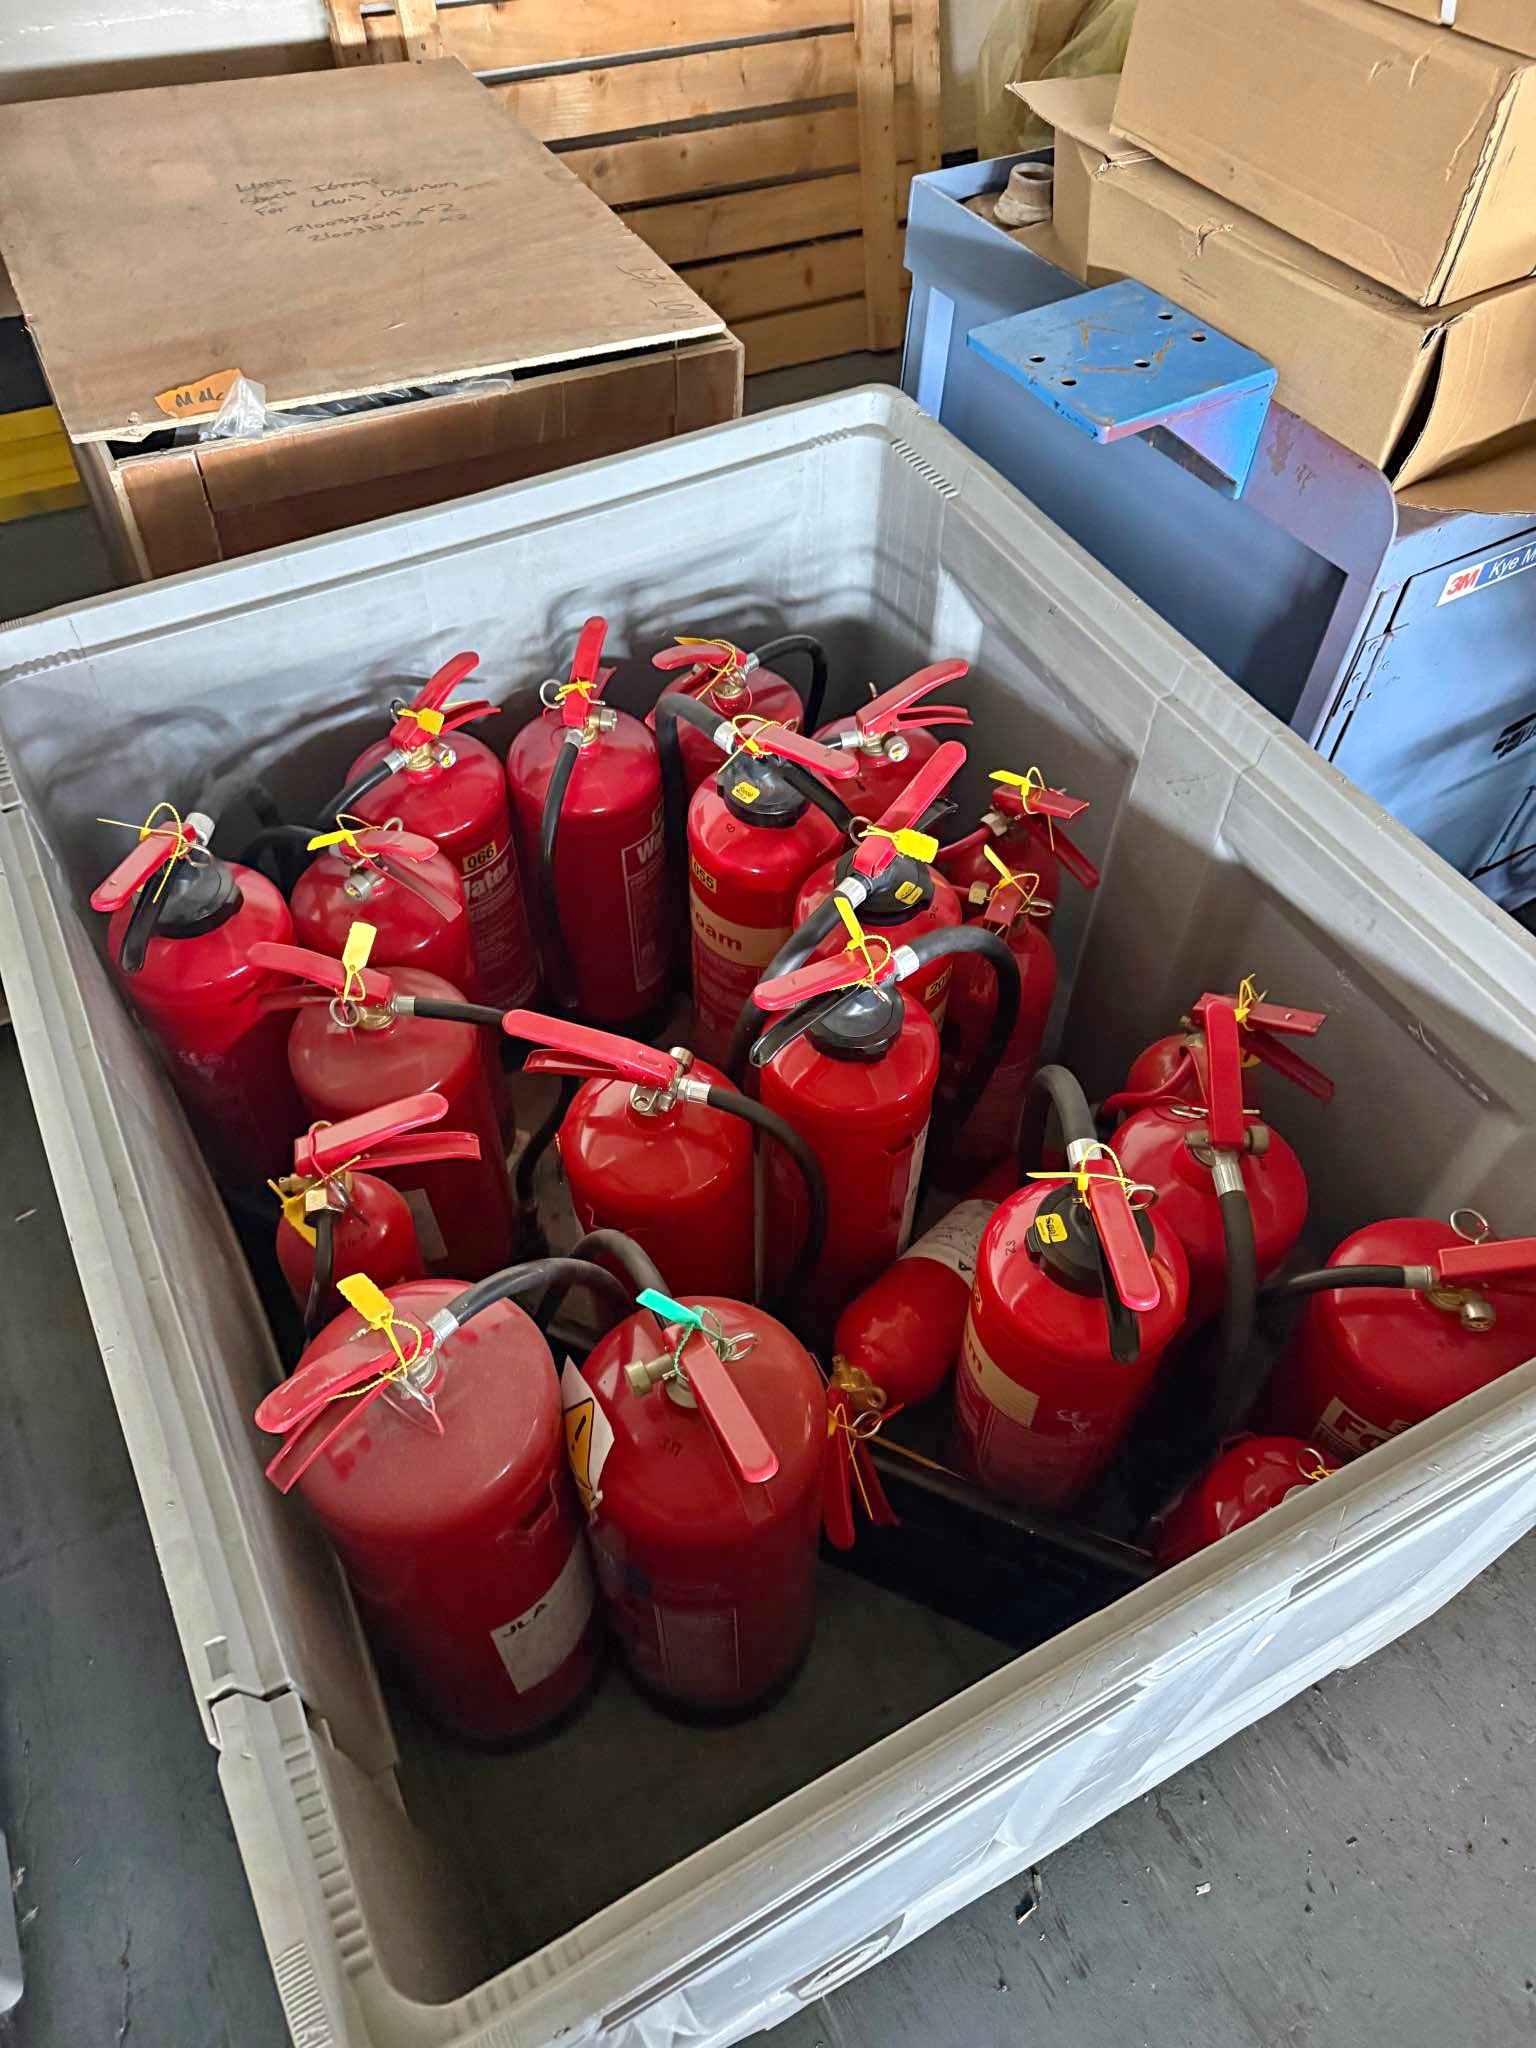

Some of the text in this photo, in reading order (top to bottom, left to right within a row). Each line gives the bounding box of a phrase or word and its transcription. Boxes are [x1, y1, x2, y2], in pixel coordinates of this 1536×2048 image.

[1446, 567, 1480, 596] 3M
[1488, 557, 1521, 579] Kye
[466, 844, 496, 869] 066
[692, 861, 714, 890] 055
[464, 855, 510, 900] ater
[693, 908, 743, 953] oam
